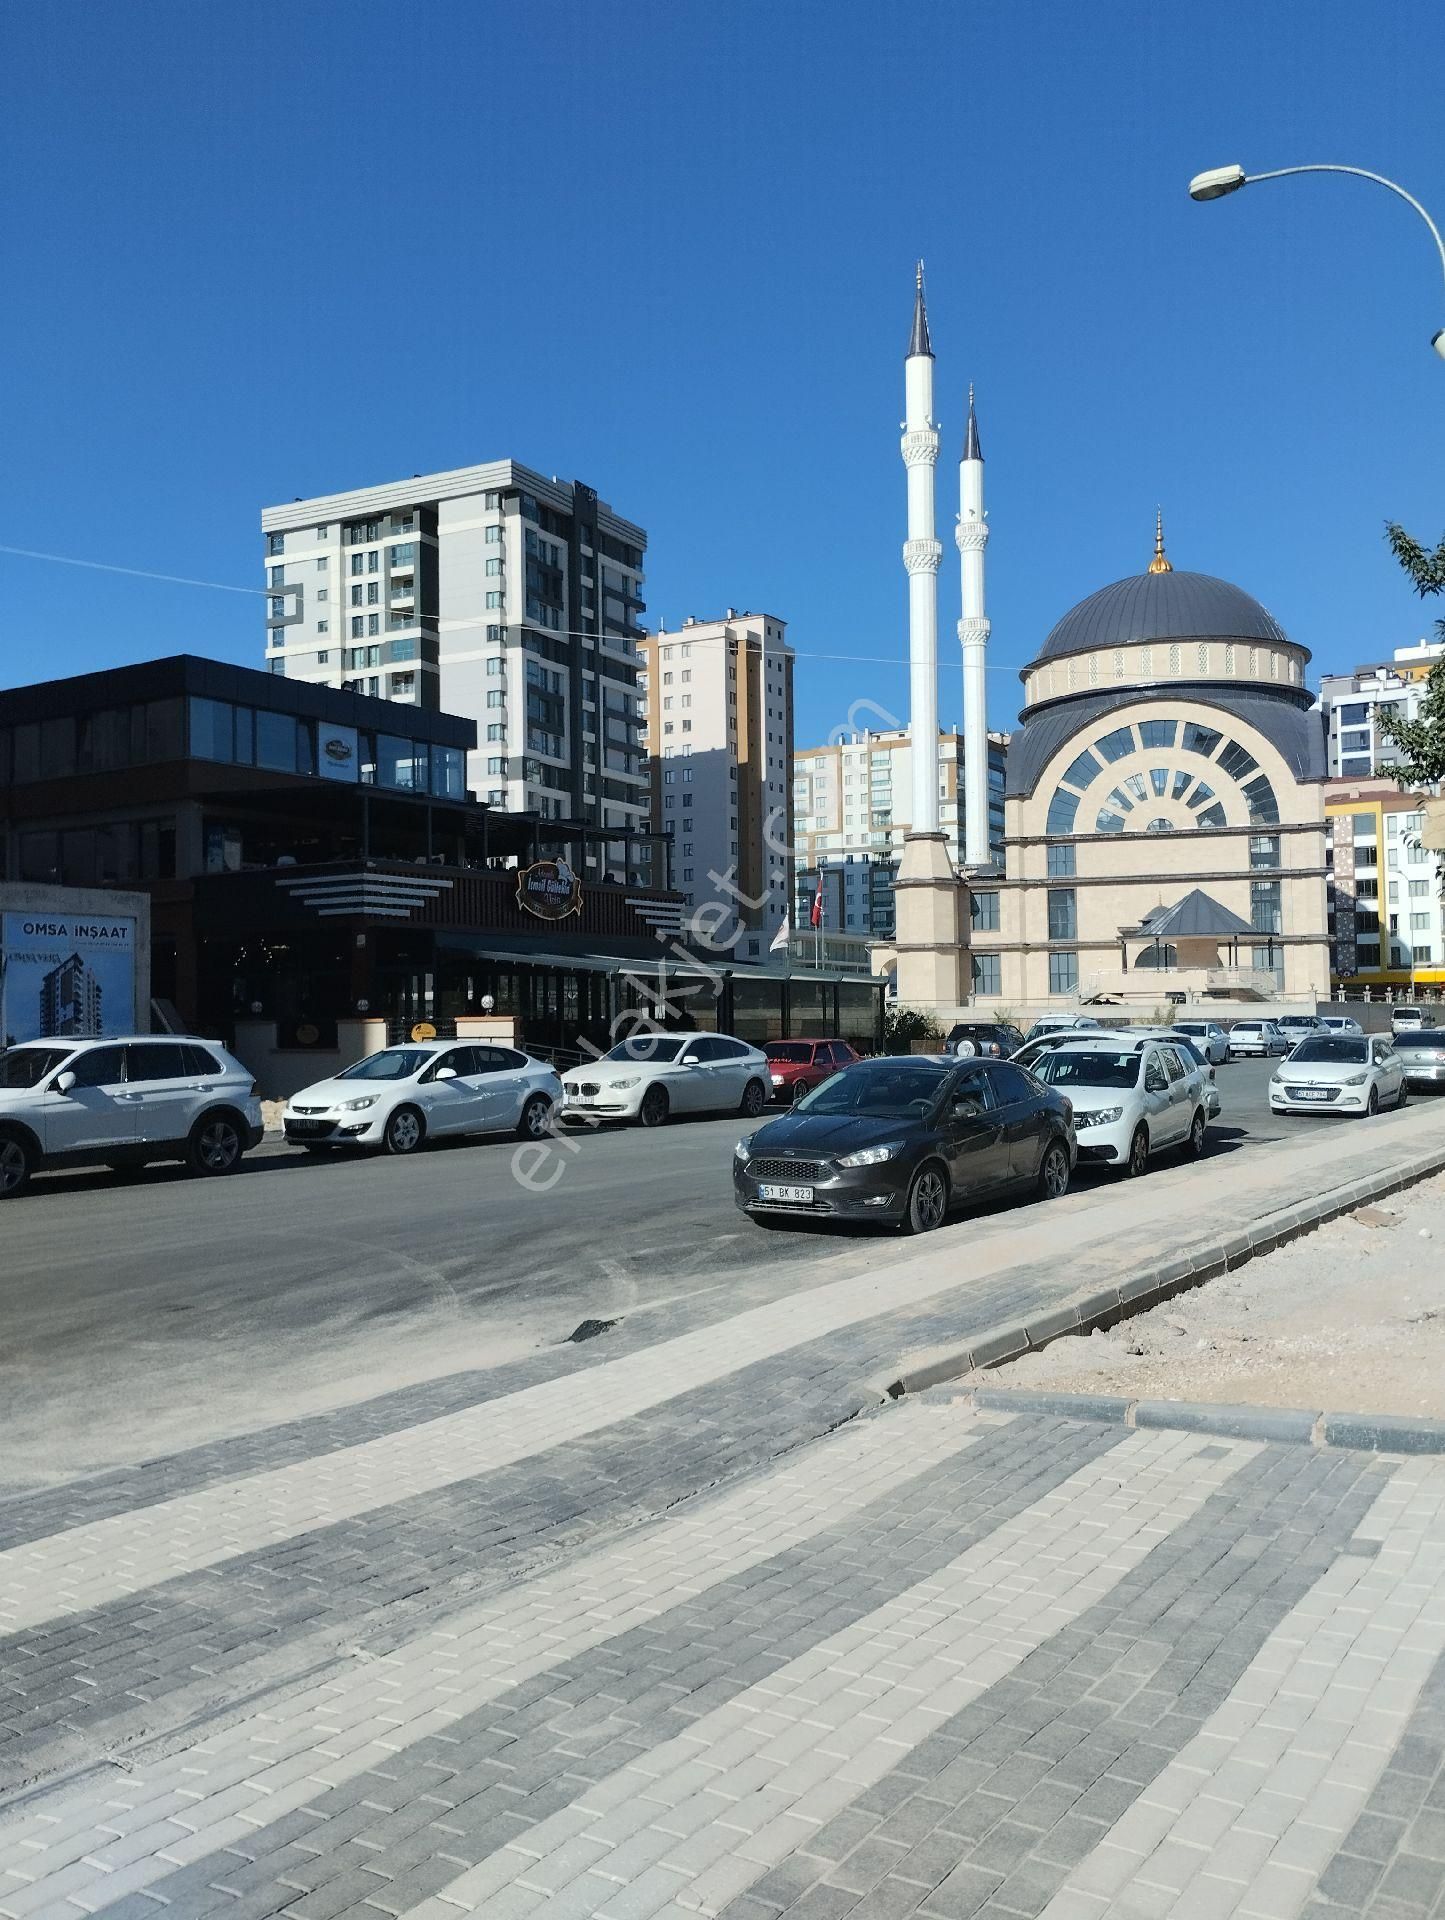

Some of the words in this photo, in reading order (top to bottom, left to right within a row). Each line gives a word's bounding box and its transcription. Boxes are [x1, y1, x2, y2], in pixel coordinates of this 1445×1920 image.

[23, 922, 67, 936] OMSA
[764, 1186, 774, 1196] 51
[779, 1188, 790, 1197] BK
[794, 1189, 811, 1199] 823
